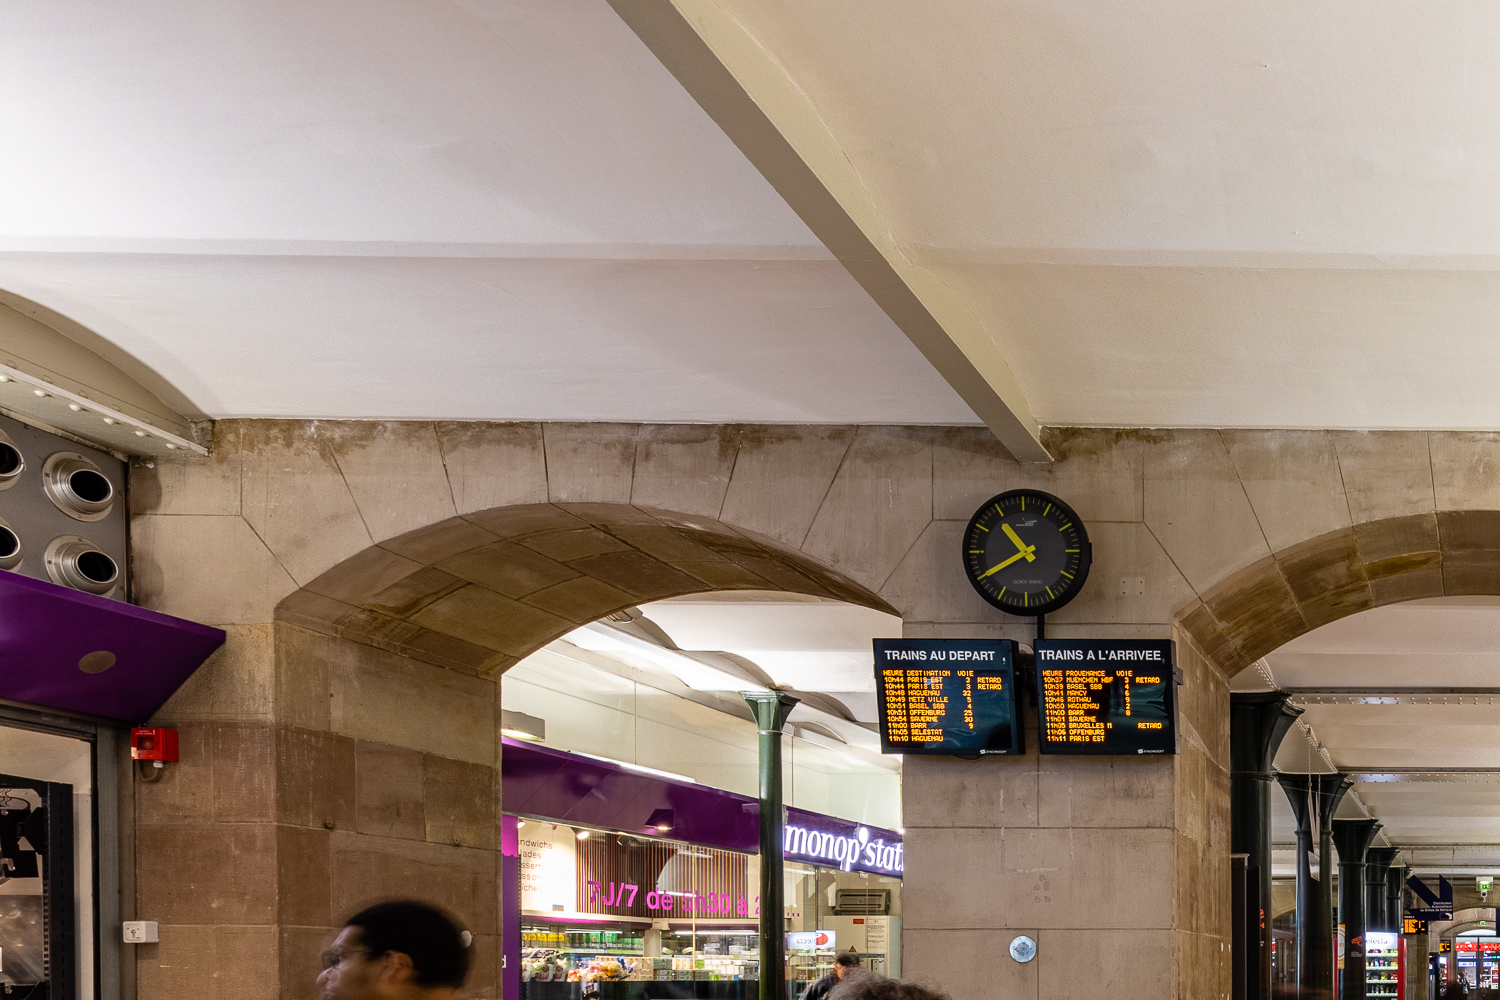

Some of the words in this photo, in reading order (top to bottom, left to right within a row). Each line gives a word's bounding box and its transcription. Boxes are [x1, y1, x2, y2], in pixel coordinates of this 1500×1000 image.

[884, 651, 927, 660] TRAINS
[930, 651, 946, 660] AU
[949, 651, 995, 660] DEPART
[1039, 650, 1084, 660] TRAINS
[1087, 650, 1095, 660] A
[1098, 650, 1161, 660] L'ARRIVEE
[786, 825, 903, 872] monop'stat
[587, 880, 638, 907] 7J/7
[647, 887, 673, 910] de
[681, 889, 730, 915] 5h30
[737, 891, 748, 915] à
